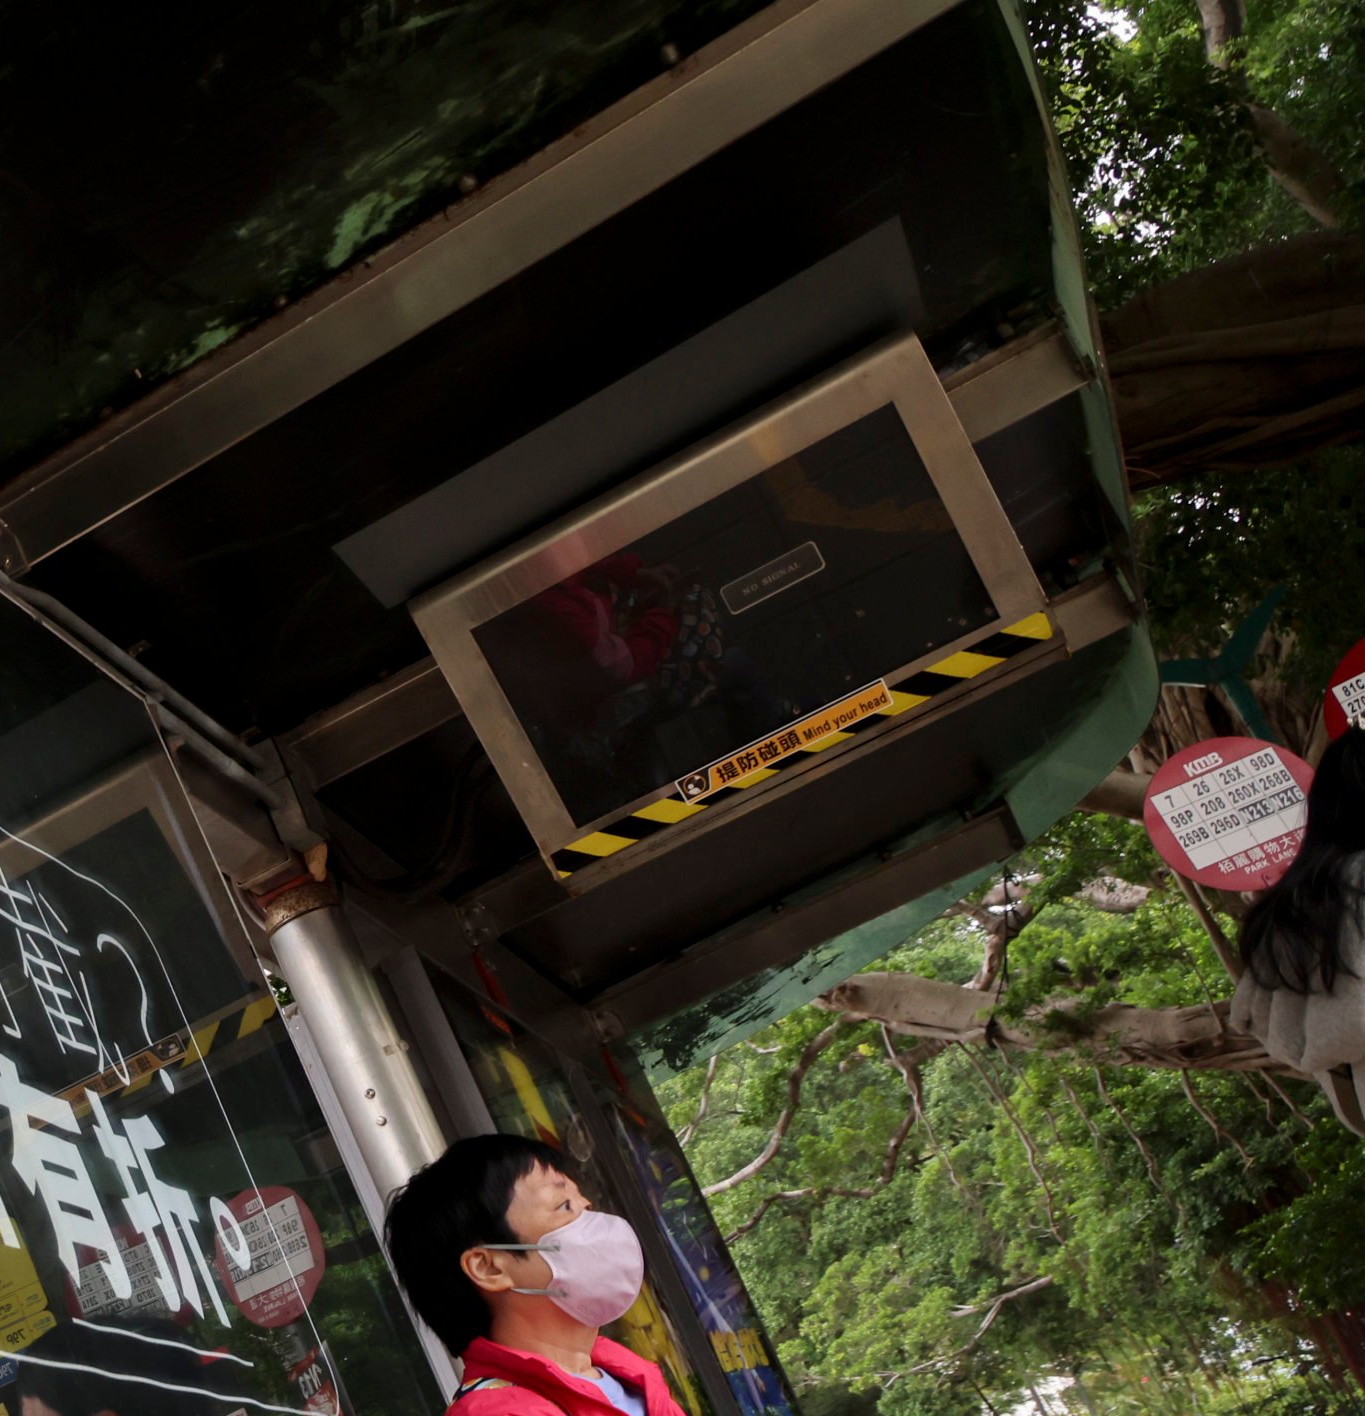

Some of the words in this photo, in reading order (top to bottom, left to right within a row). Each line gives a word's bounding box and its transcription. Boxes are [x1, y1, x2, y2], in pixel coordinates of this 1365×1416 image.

[742, 583, 758, 596] NO
[761, 561, 802, 586] SIGNAL
[716, 730, 803, 784] 提防碰頭
[804, 720, 831, 742] Mind
[832, 708, 858, 730] your
[860, 692, 887, 714] head
[1183, 752, 1224, 778] KMB
[1164, 794, 1175, 809] 7
[1193, 780, 1211, 797] 26
[1219, 766, 1246, 786] 26X
[1250, 752, 1276, 772] 98D
[1170, 809, 1194, 829] 98P
[1200, 796, 1226, 816] 208
[1228, 782, 1260, 805] 260X
[1259, 769, 1292, 791] 268B
[1179, 826, 1210, 849] 269B
[1210, 813, 1241, 835] 296D
[1241, 800, 1274, 824] N213
[1275, 786, 1305, 811] N216
[1244, 860, 1269, 875] PARK
[1272, 848, 1297, 864] LANE
